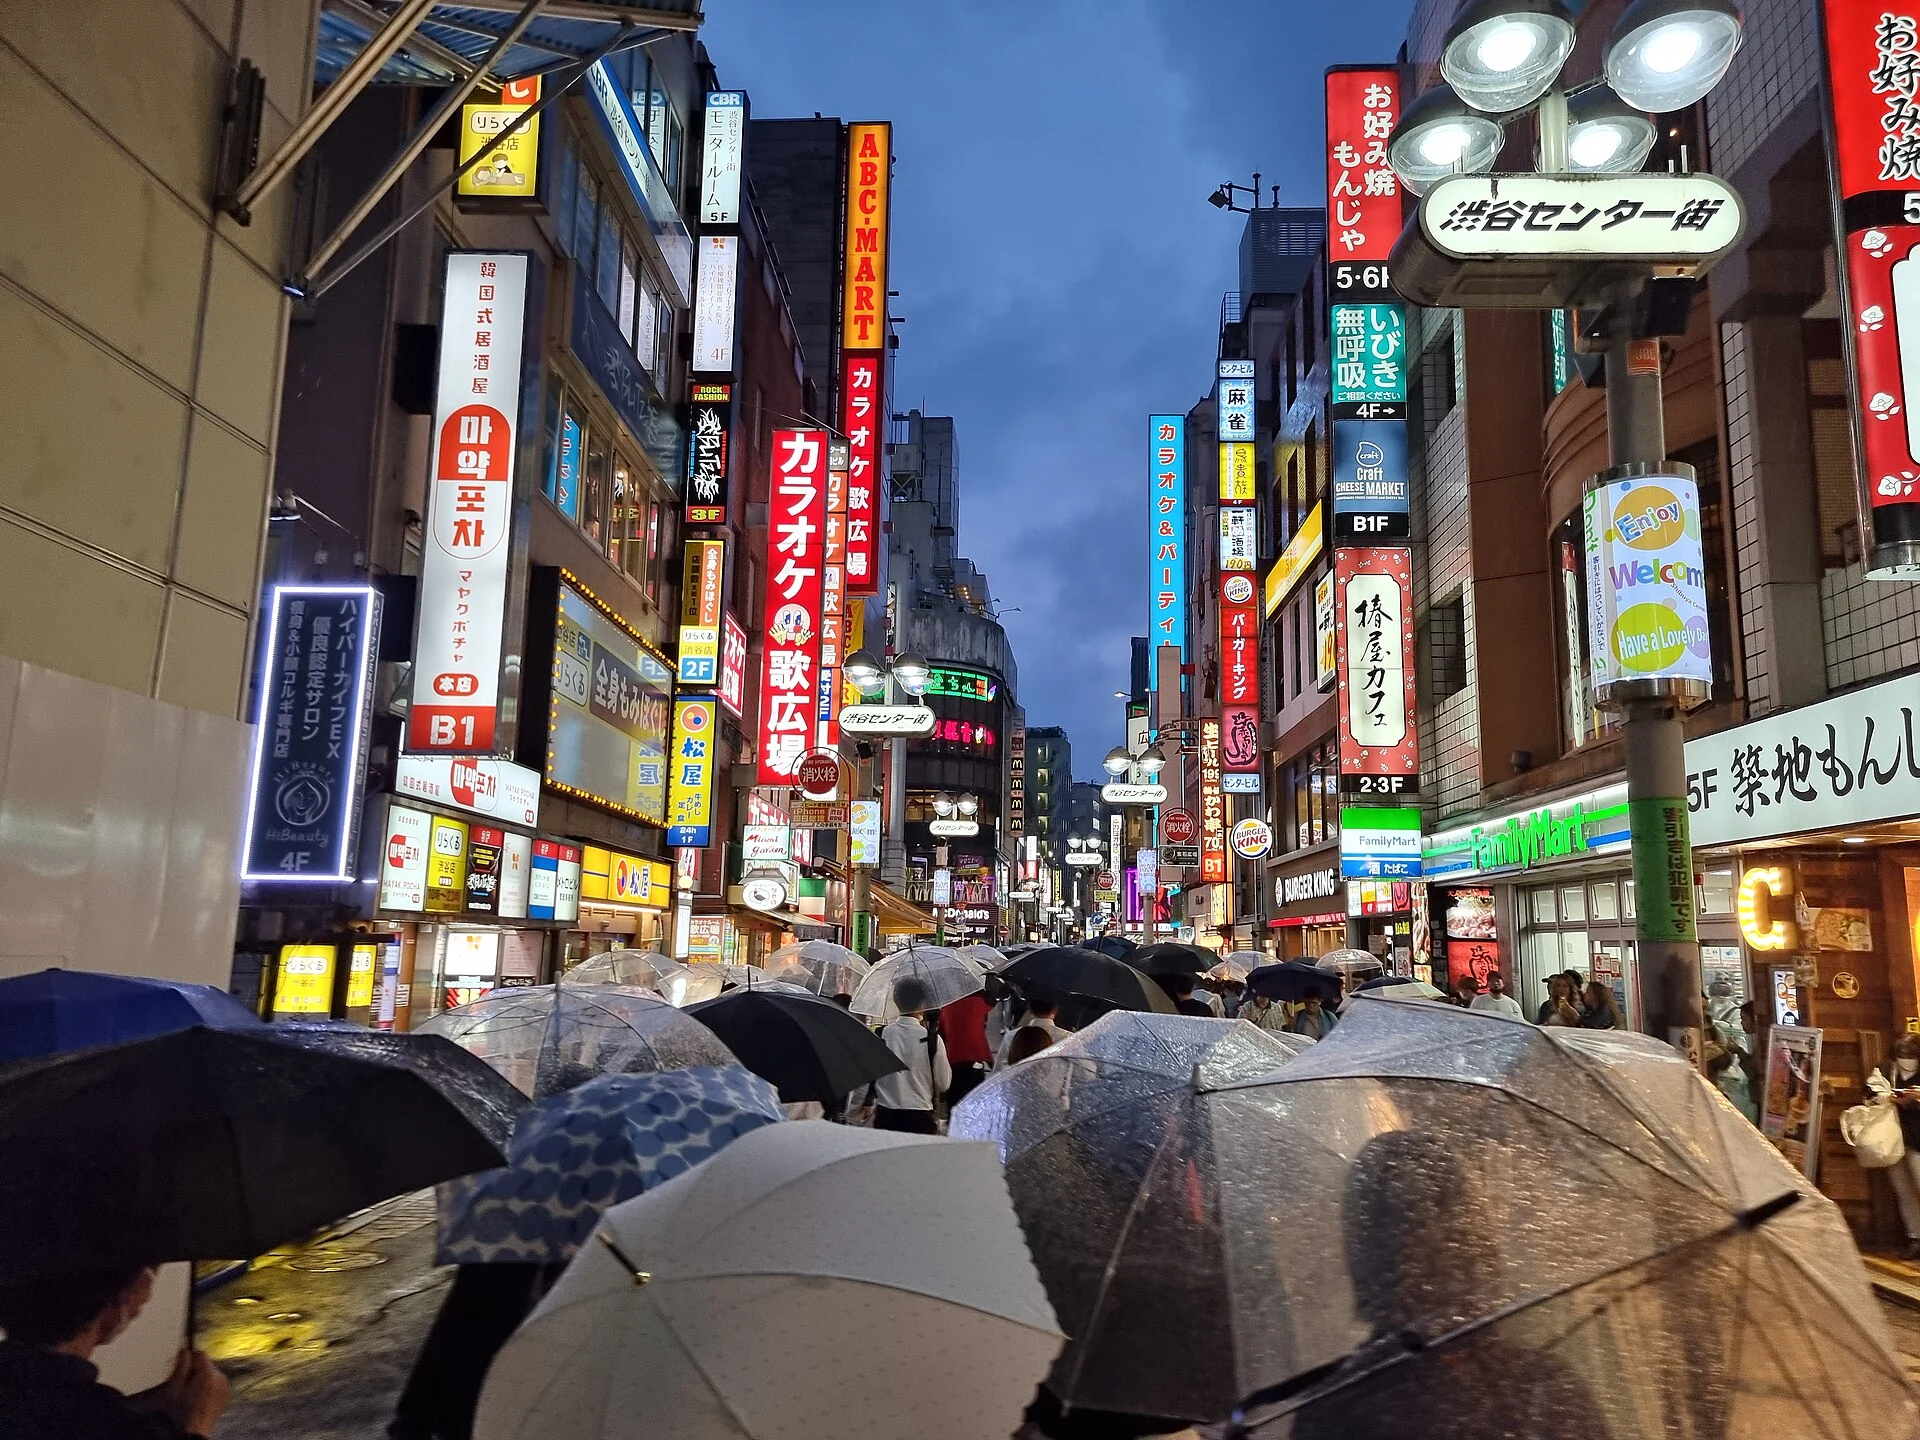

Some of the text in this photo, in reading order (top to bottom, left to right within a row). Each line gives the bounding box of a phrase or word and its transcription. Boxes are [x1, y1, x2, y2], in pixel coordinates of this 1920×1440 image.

[710, 93, 740, 104] CBR
[477, 116, 525, 129] りらく
[727, 110, 737, 171] 渋谷センター街
[1363, 84, 1395, 196] お好み焼
[706, 111, 724, 206] モニタールーム
[1333, 141, 1366, 252] もんじゃ
[710, 212, 728, 221] 5F
[1439, 200, 1724, 232] 渋谷センター街
[471, 262, 496, 394] 韓国式居酒屋
[711, 348, 728, 361] 4F
[1336, 308, 1367, 389] 無呼吸
[1370, 308, 1401, 388] いびき
[1220, 364, 1253, 374] センタービル
[694, 393, 728, 401] FASHION
[1228, 388, 1246, 431] 麻雀
[1337, 391, 1400, 401] ご相談ください
[1355, 404, 1380, 418] 4F
[452, 416, 493, 547] 마약포차
[847, 368, 872, 577] カラオケ歌広場
[1356, 467, 1383, 481] Craft
[1336, 482, 1404, 496] CHEESE MARKET
[691, 509, 720, 520] 3F
[773, 433, 820, 600] カラオケ
[1353, 516, 1388, 532] B1F
[1615, 501, 1679, 543] Enjoy
[704, 547, 719, 623] 全身もみほぐし
[1609, 558, 1704, 590] Welcom
[1670, 582, 1692, 604] Shibuya
[685, 632, 713, 640] りらくる
[1618, 630, 1650, 661] Have
[1651, 634, 1659, 651] a
[1659, 625, 1696, 649] Lovely
[685, 661, 710, 676] 2F
[1232, 614, 1246, 700] バーガーキング
[1354, 593, 1394, 727] 椿屋カフェ
[302, 617, 332, 741] 優良認定サロン
[326, 600, 358, 759] ハイパーナイフEX
[439, 676, 473, 693] 本店
[594, 657, 666, 742] 全身もみほぐし
[766, 650, 811, 776] 歌広場
[430, 715, 475, 746] B1
[843, 714, 929, 725] 渋谷センター街
[680, 737, 706, 786] 松屋
[802, 766, 836, 783] 消火栓
[453, 763, 496, 798] 마약포차
[1224, 777, 1258, 788] センタービル
[1687, 768, 1718, 812] 5F
[677, 801, 686, 822] 定食
[694, 793, 702, 816] 牛めし
[793, 807, 825, 815] iPhone
[438, 832, 461, 851] りらくる
[1166, 824, 1191, 834] 消火栓
[1236, 827, 1267, 850] BURGER KING
[1359, 835, 1416, 847] FamilyMart
[1471, 802, 1586, 870] FamilyMart
[280, 852, 311, 872] 4F
[1205, 858, 1222, 873] B1
[1368, 863, 1409, 875] 酒 たばこ
[1663, 807, 1690, 933] 客引きは犯罪です
[629, 866, 650, 898] 松屋
[1284, 871, 1315, 902] BURGER
[1314, 868, 1335, 897] KING
